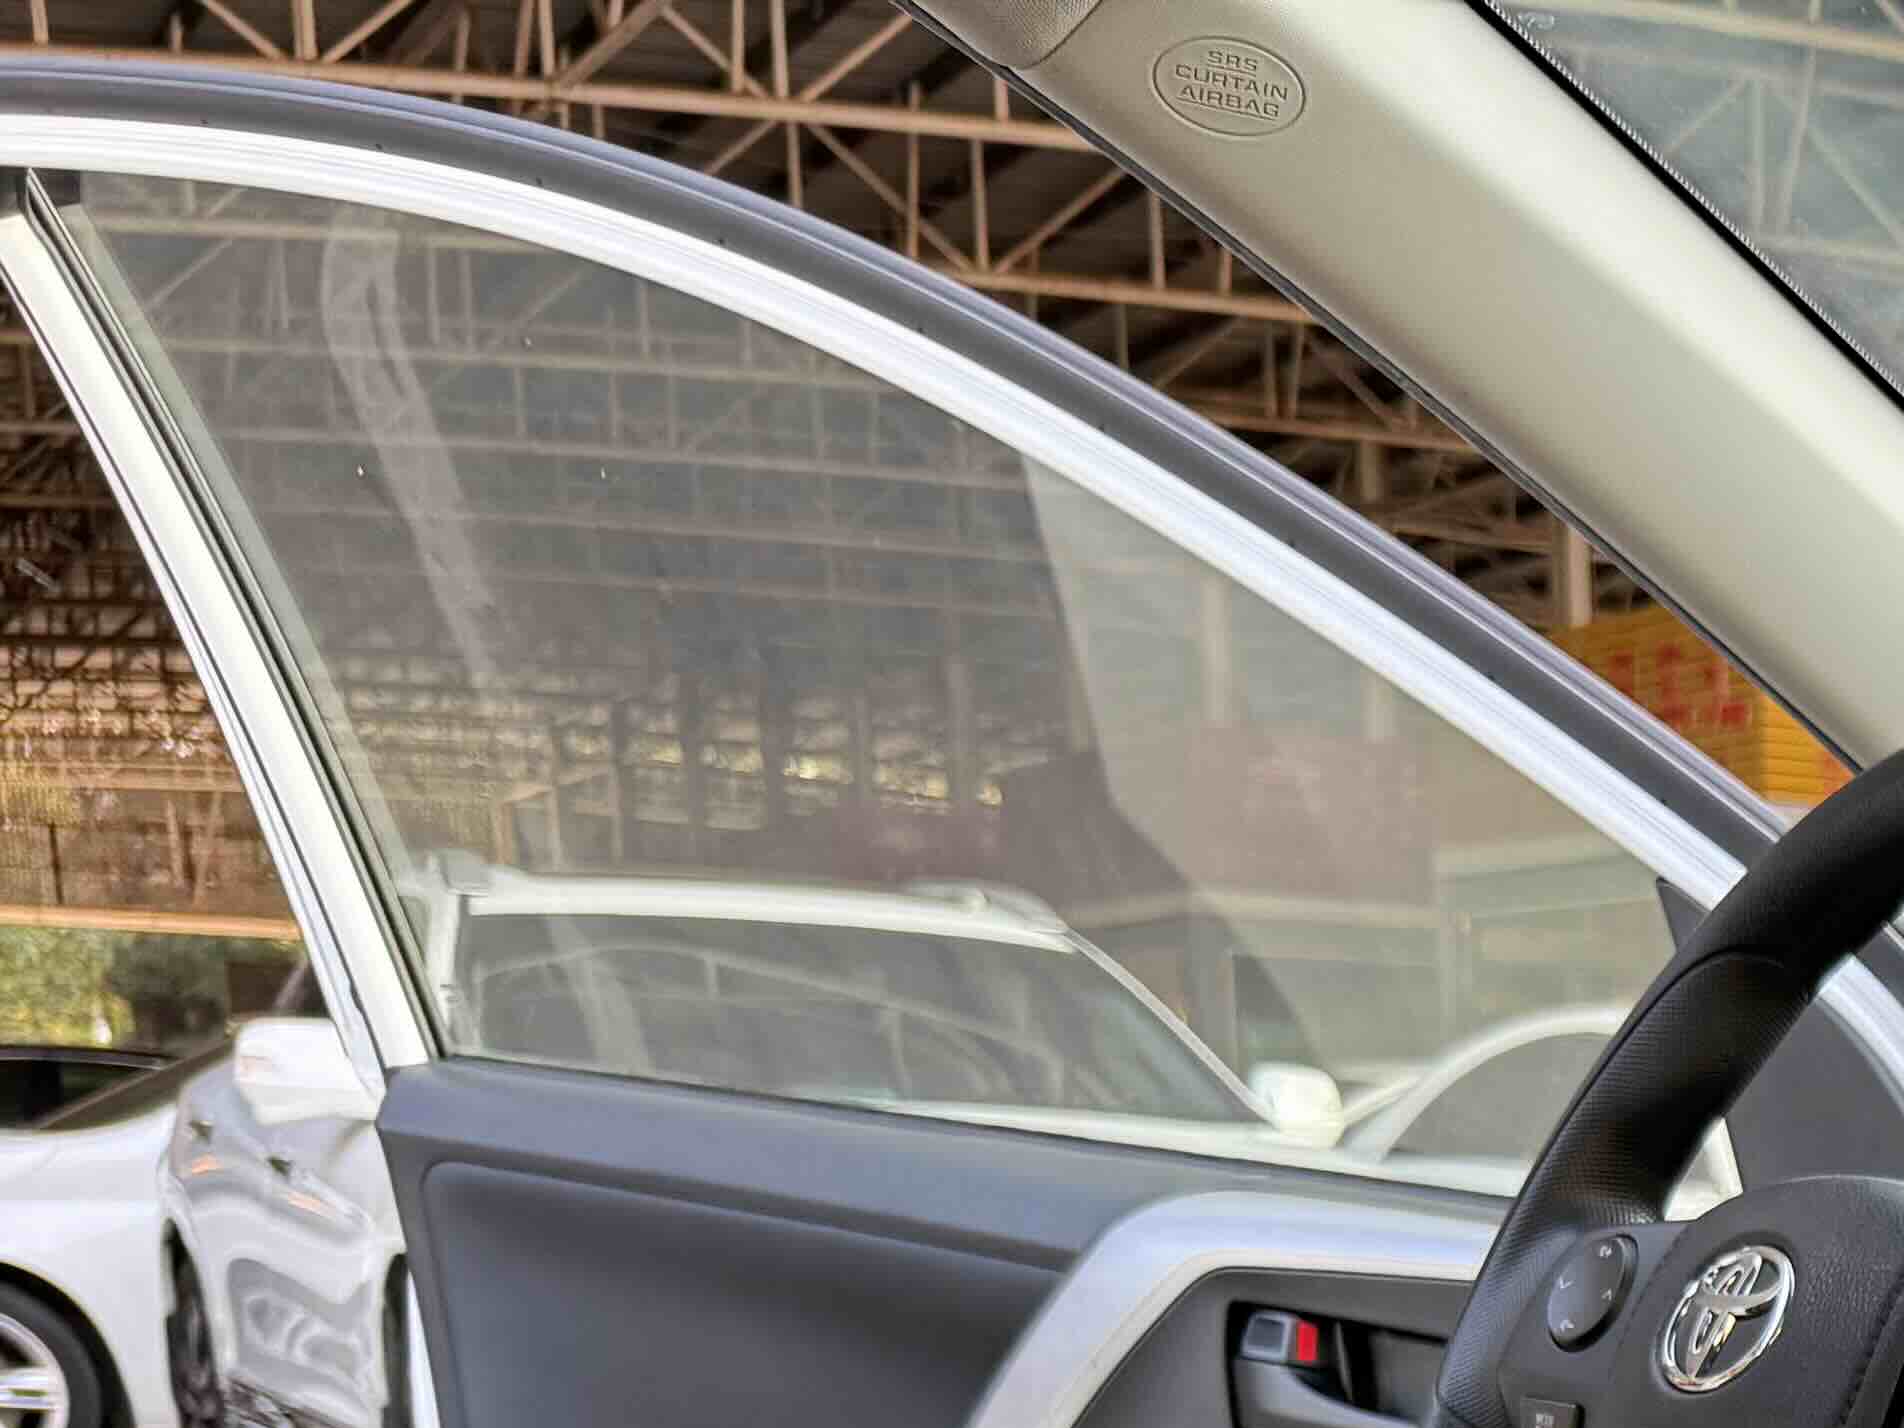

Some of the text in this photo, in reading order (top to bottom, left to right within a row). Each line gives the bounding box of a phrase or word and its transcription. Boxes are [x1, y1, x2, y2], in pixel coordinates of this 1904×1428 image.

[1207, 50, 1259, 72] SRS
[1175, 63, 1289, 101] CURTAIN
[1179, 85, 1280, 118] AIRBAG
